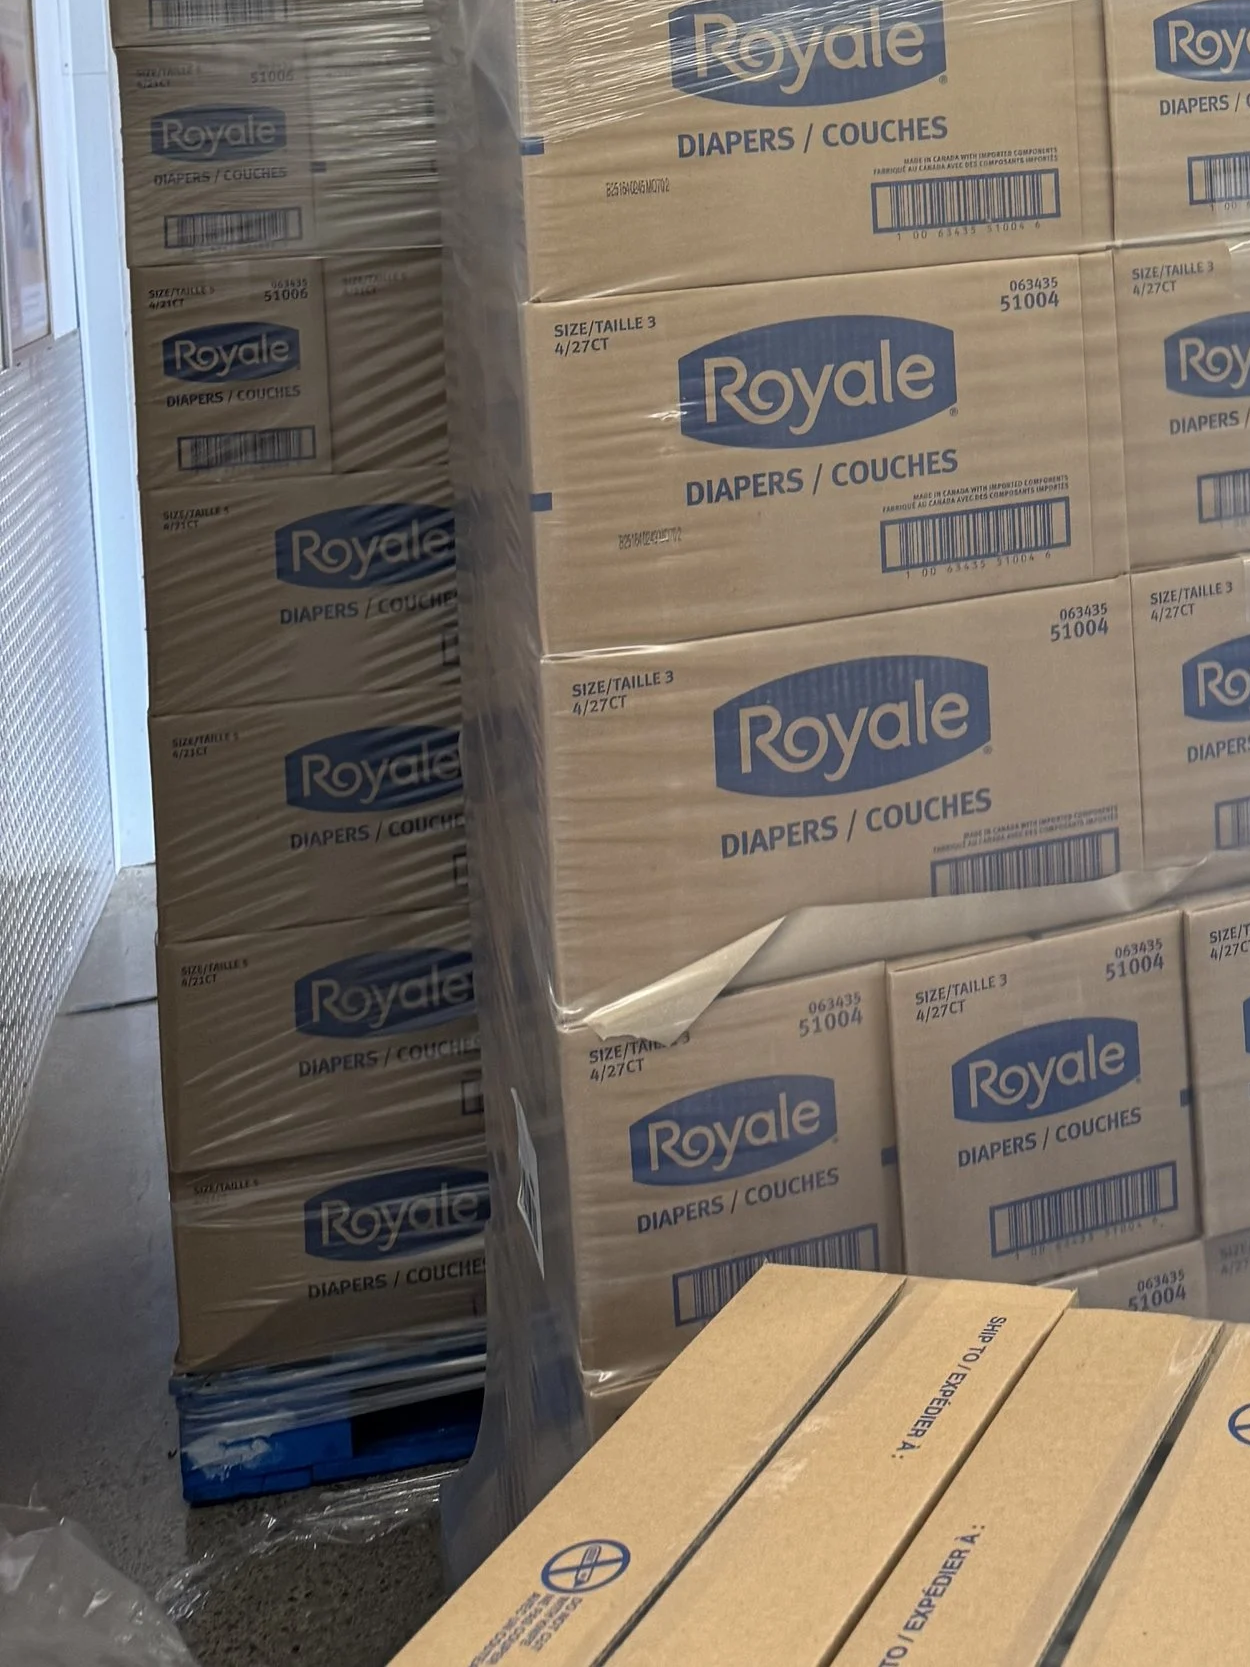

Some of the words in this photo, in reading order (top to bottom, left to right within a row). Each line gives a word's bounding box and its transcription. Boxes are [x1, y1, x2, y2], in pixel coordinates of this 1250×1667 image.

[693, 6, 925, 95] Royale
[1159, 95, 1229, 116] DIAPERS
[162, 115, 275, 156] Royale
[678, 127, 794, 158] DIAPERS
[822, 116, 947, 147] COUCHES
[999, 292, 1059, 312] 51004
[1009, 277, 1058, 291] 063435
[554, 318, 644, 337] SIZE/TAILLE
[554, 337, 609, 356] 4/27CT
[175, 332, 289, 378] Royale
[704, 339, 935, 435] Royale
[686, 468, 803, 507] DIAPERS
[831, 449, 959, 487] COUCHES
[1050, 619, 1109, 642] 51004
[738, 678, 970, 782] Royale
[720, 818, 838, 860] DIAPERS
[866, 788, 992, 833] COUCHES
[1104, 955, 1165, 982] 51004
[968, 1034, 1126, 1110] Royale
[648, 1094, 822, 1172] Royale
[321, 1184, 479, 1252] Royale
[978, 1316, 1007, 1344] SHIP
[962, 1346, 987, 1362] TO
[907, 1372, 967, 1438] EXPÉDIER
[878, 1646, 908, 1667] TO
[903, 1548, 971, 1632] EXPÉDIER
